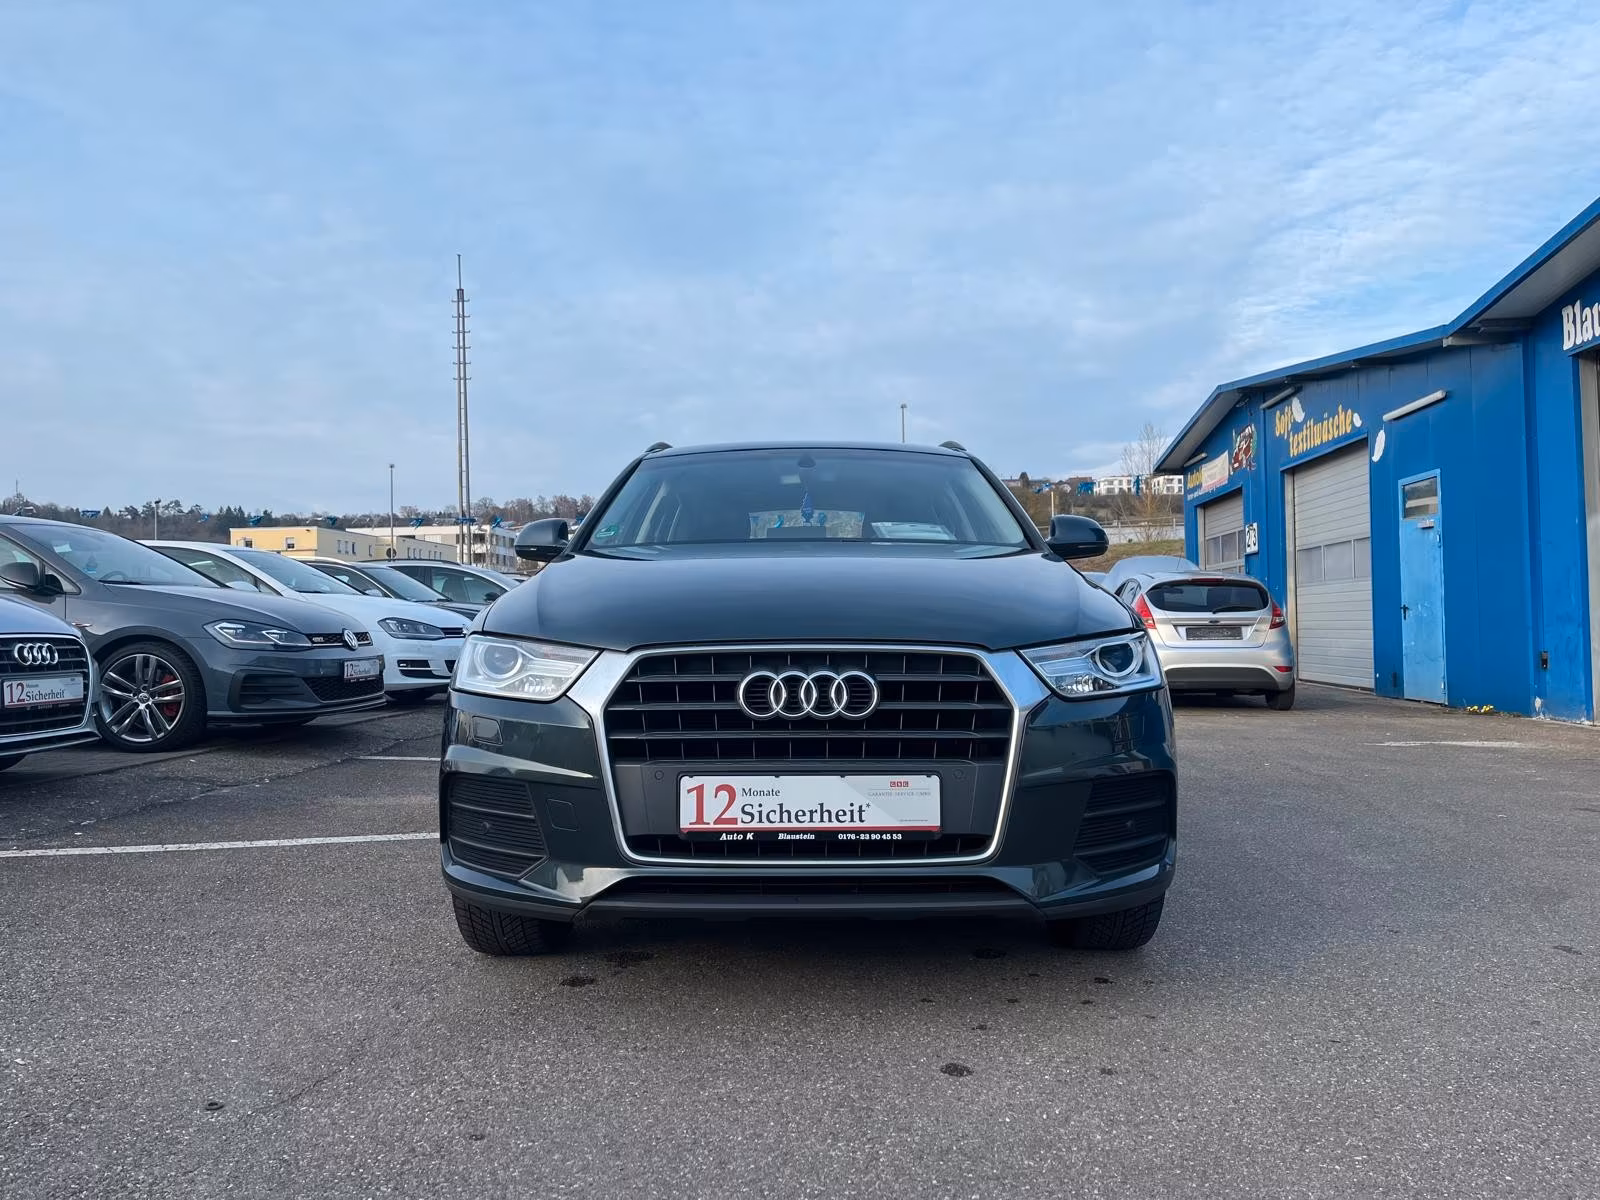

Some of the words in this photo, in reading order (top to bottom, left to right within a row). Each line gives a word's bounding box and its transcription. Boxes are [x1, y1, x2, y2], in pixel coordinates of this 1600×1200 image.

[1290, 403, 1352, 458] textilwäsche
[6, 682, 25, 704] 12
[741, 788, 780, 797] Monate
[687, 783, 738, 825] 12
[720, 832, 743, 840] Auto
[746, 832, 754, 840] K
